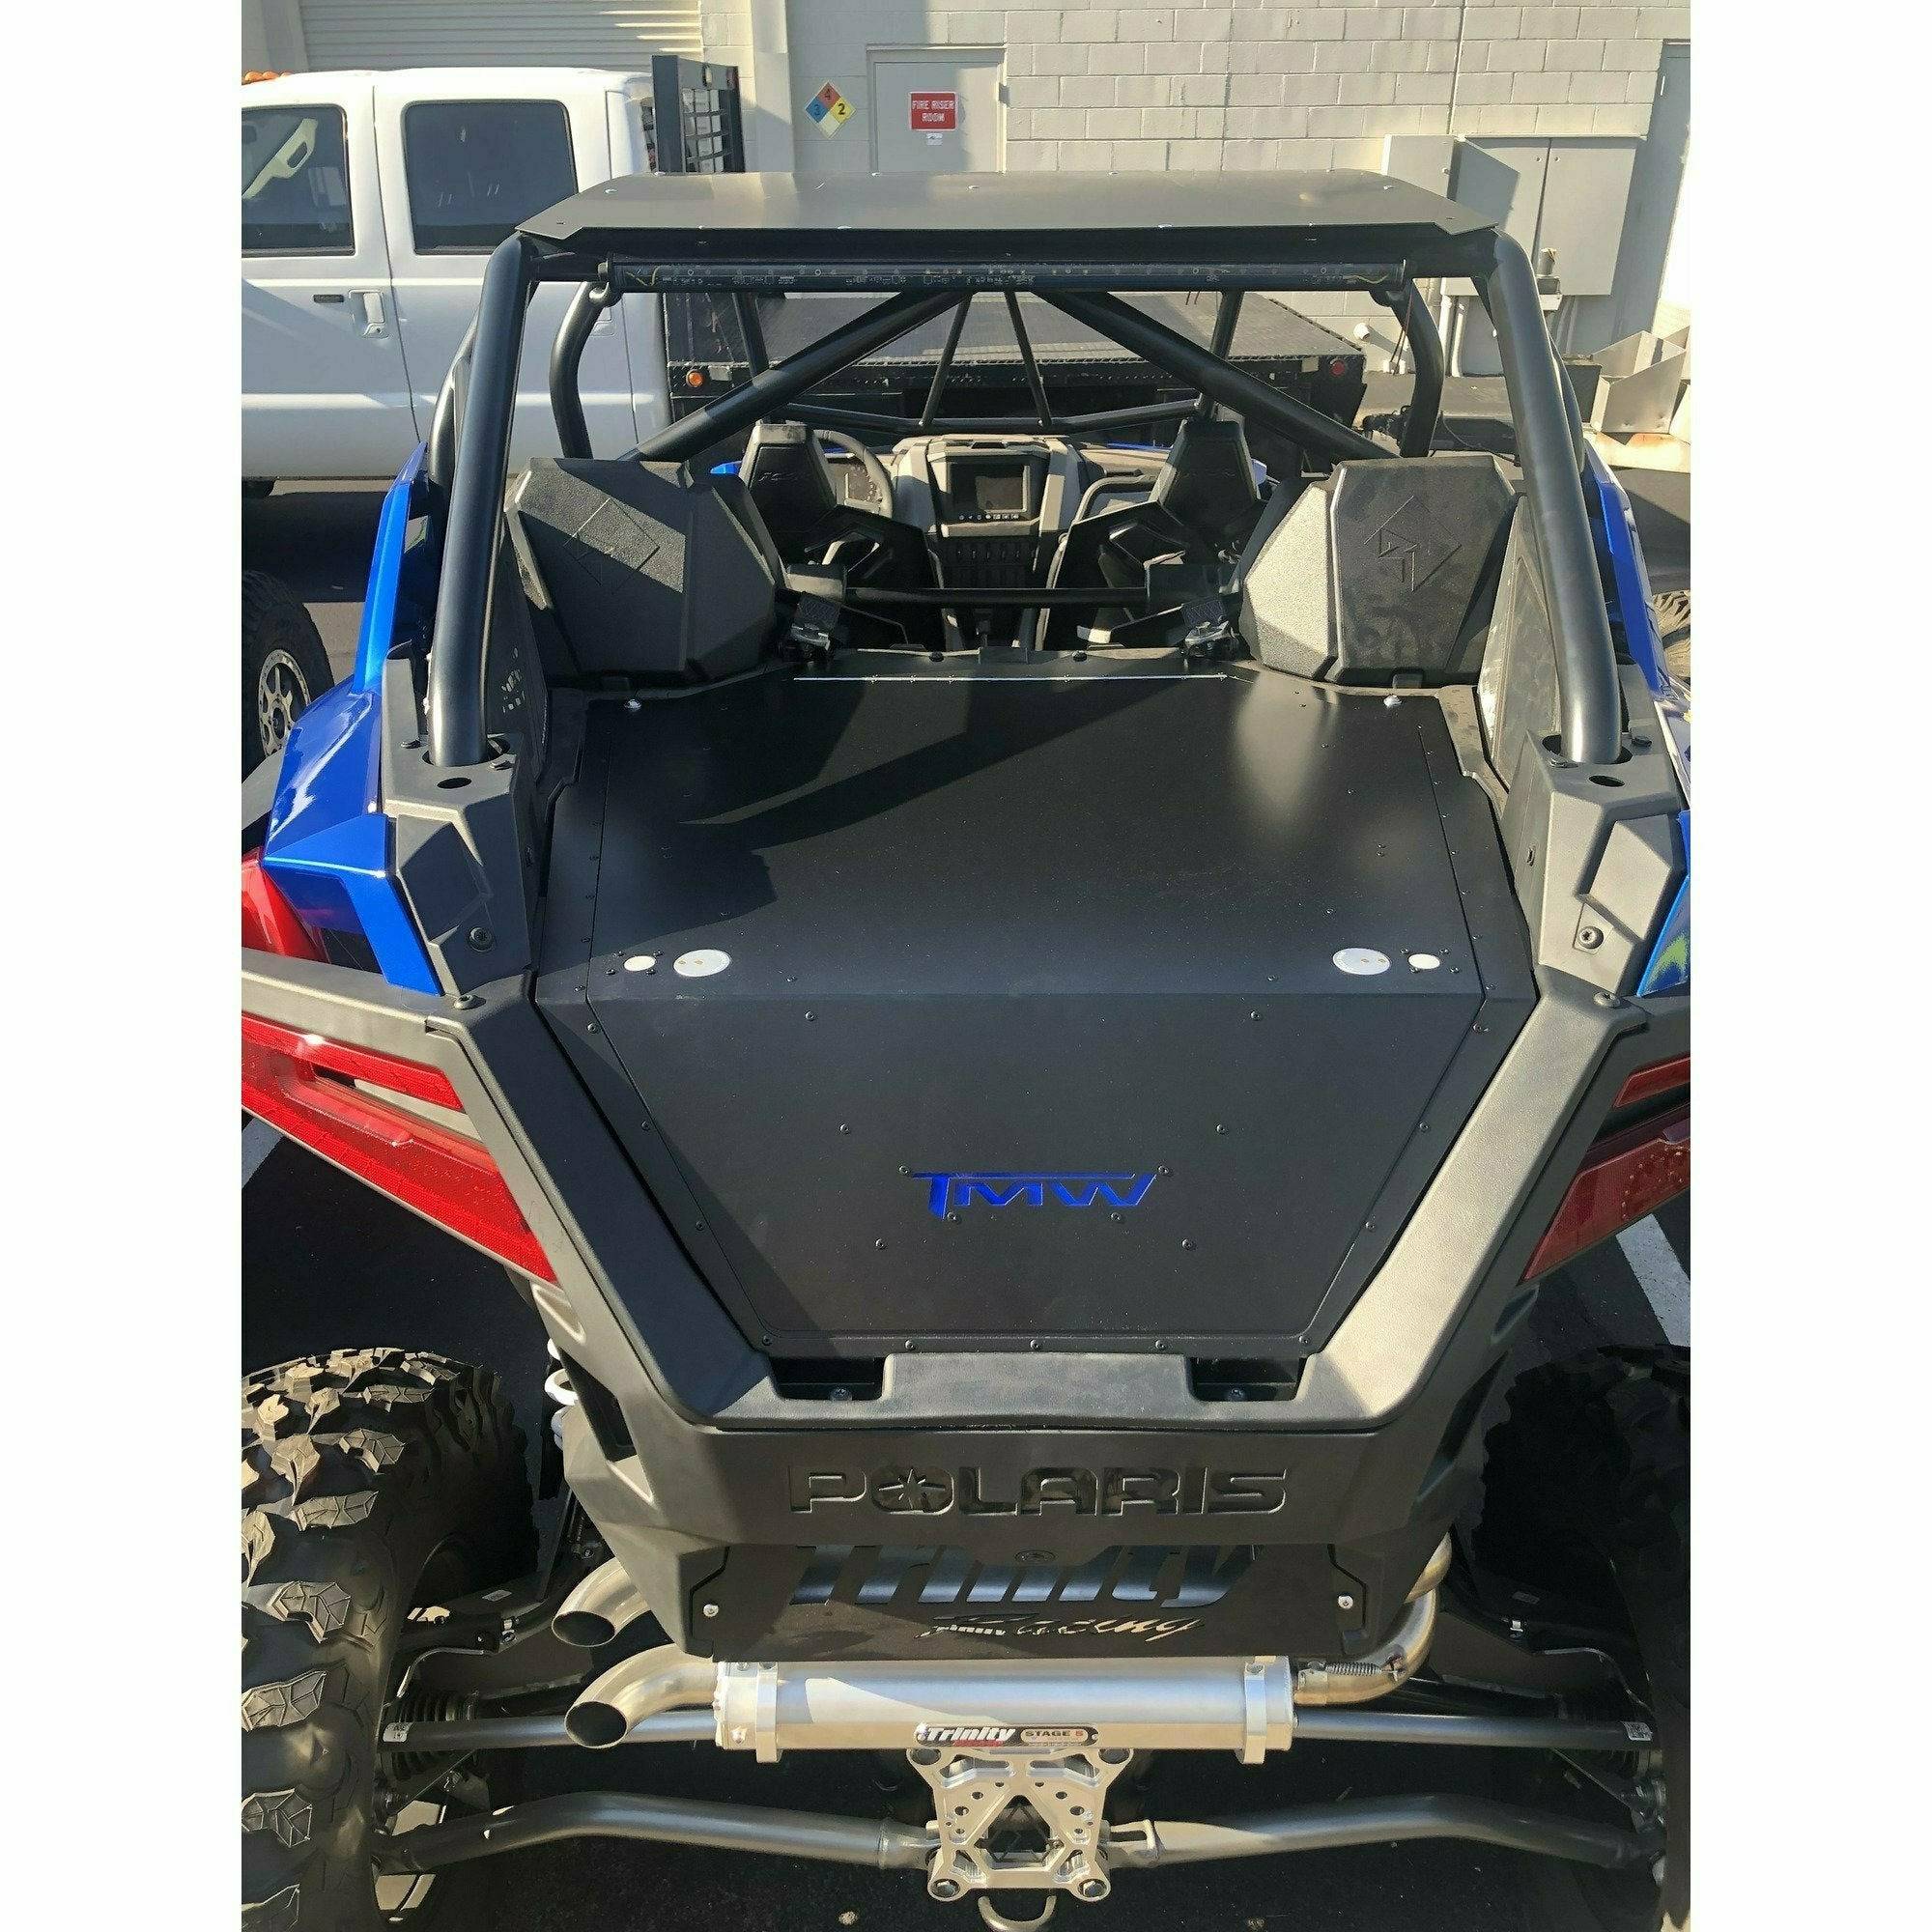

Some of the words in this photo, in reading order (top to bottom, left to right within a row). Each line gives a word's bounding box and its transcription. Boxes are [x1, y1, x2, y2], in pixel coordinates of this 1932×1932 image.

[824, 88, 832, 100] 4
[813, 103, 821, 116] 3
[838, 102, 846, 115] 2
[912, 99, 929, 110] FIRE
[931, 99, 954, 110] RISER
[922, 112, 946, 123] ROOM
[912, 1171, 1157, 1221] TMW
[787, 1465, 1292, 1517] POLARIS
[926, 1726, 1016, 1742] Trinity
[1024, 1729, 1071, 1738] STAGE
